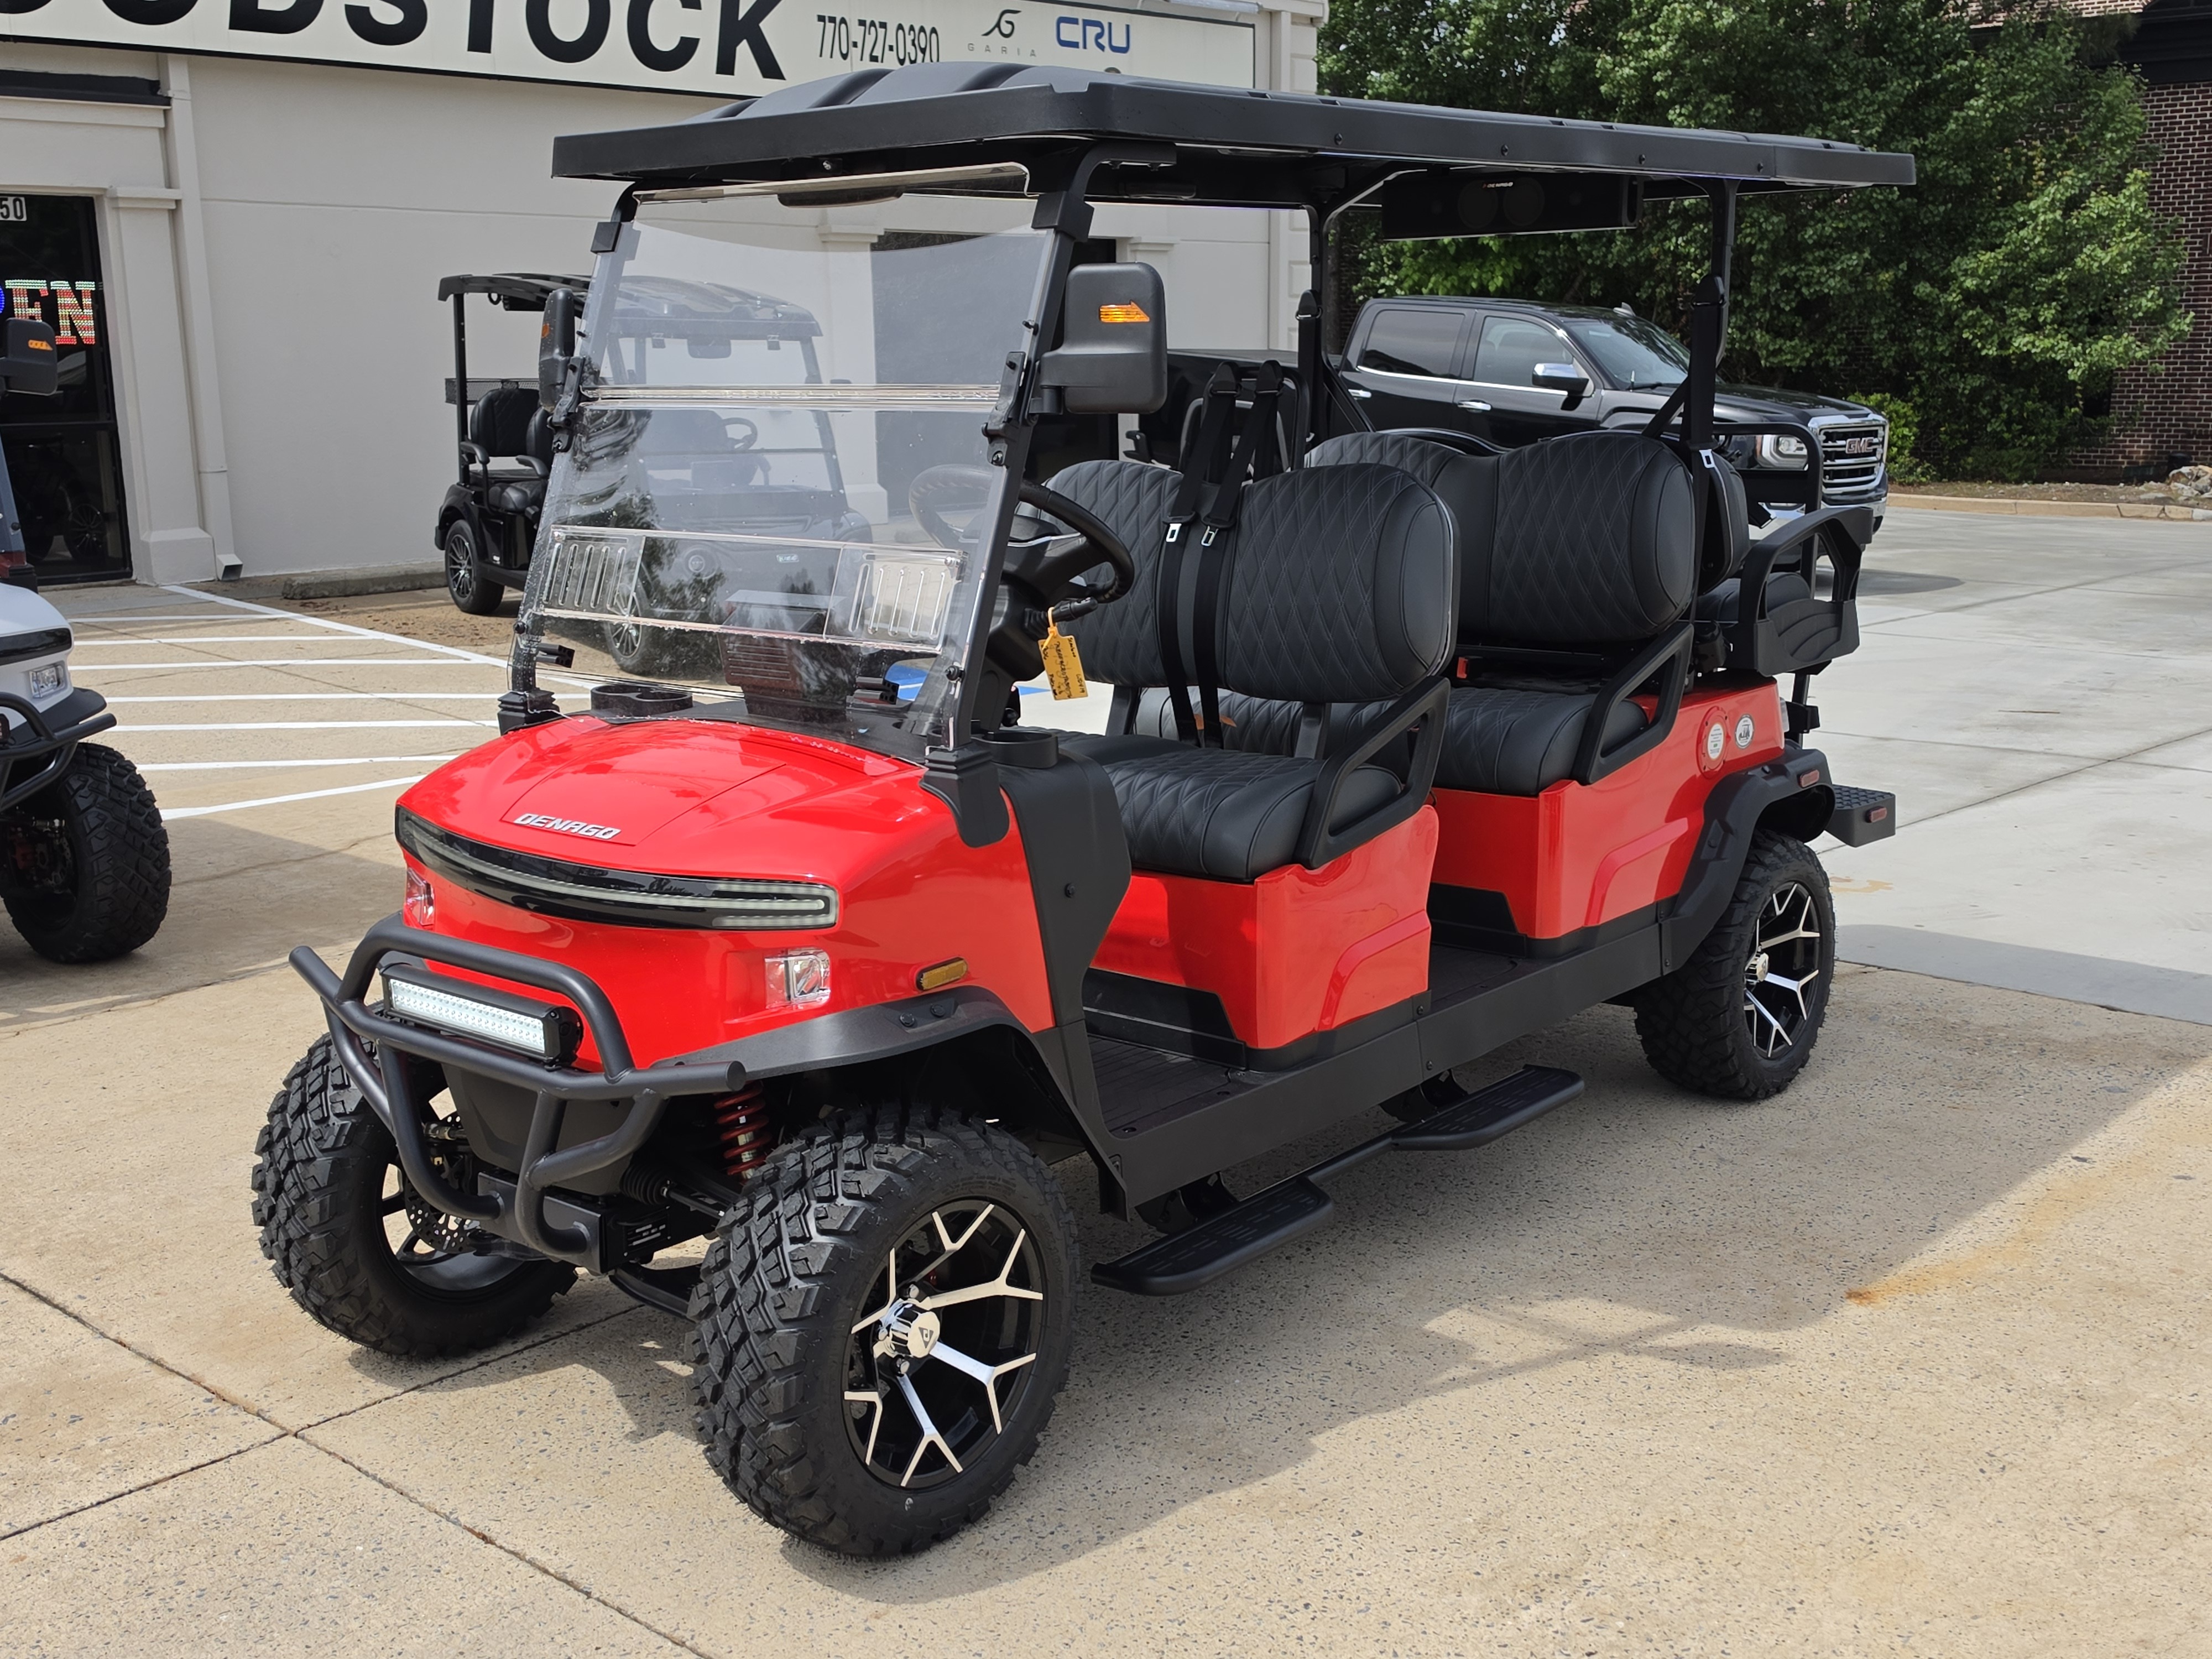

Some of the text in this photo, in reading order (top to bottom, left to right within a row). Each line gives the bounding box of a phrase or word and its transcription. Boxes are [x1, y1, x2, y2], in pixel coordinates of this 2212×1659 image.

[0, 0, 786, 81] TOCK
[817, 14, 940, 66] 770-727-0390
[968, 43, 1036, 57] GARIA
[1056, 16, 1130, 54] CRU
[0, 279, 95, 345] EN
[1845, 437, 1874, 454] GMC
[513, 813, 622, 840] DENAGO
